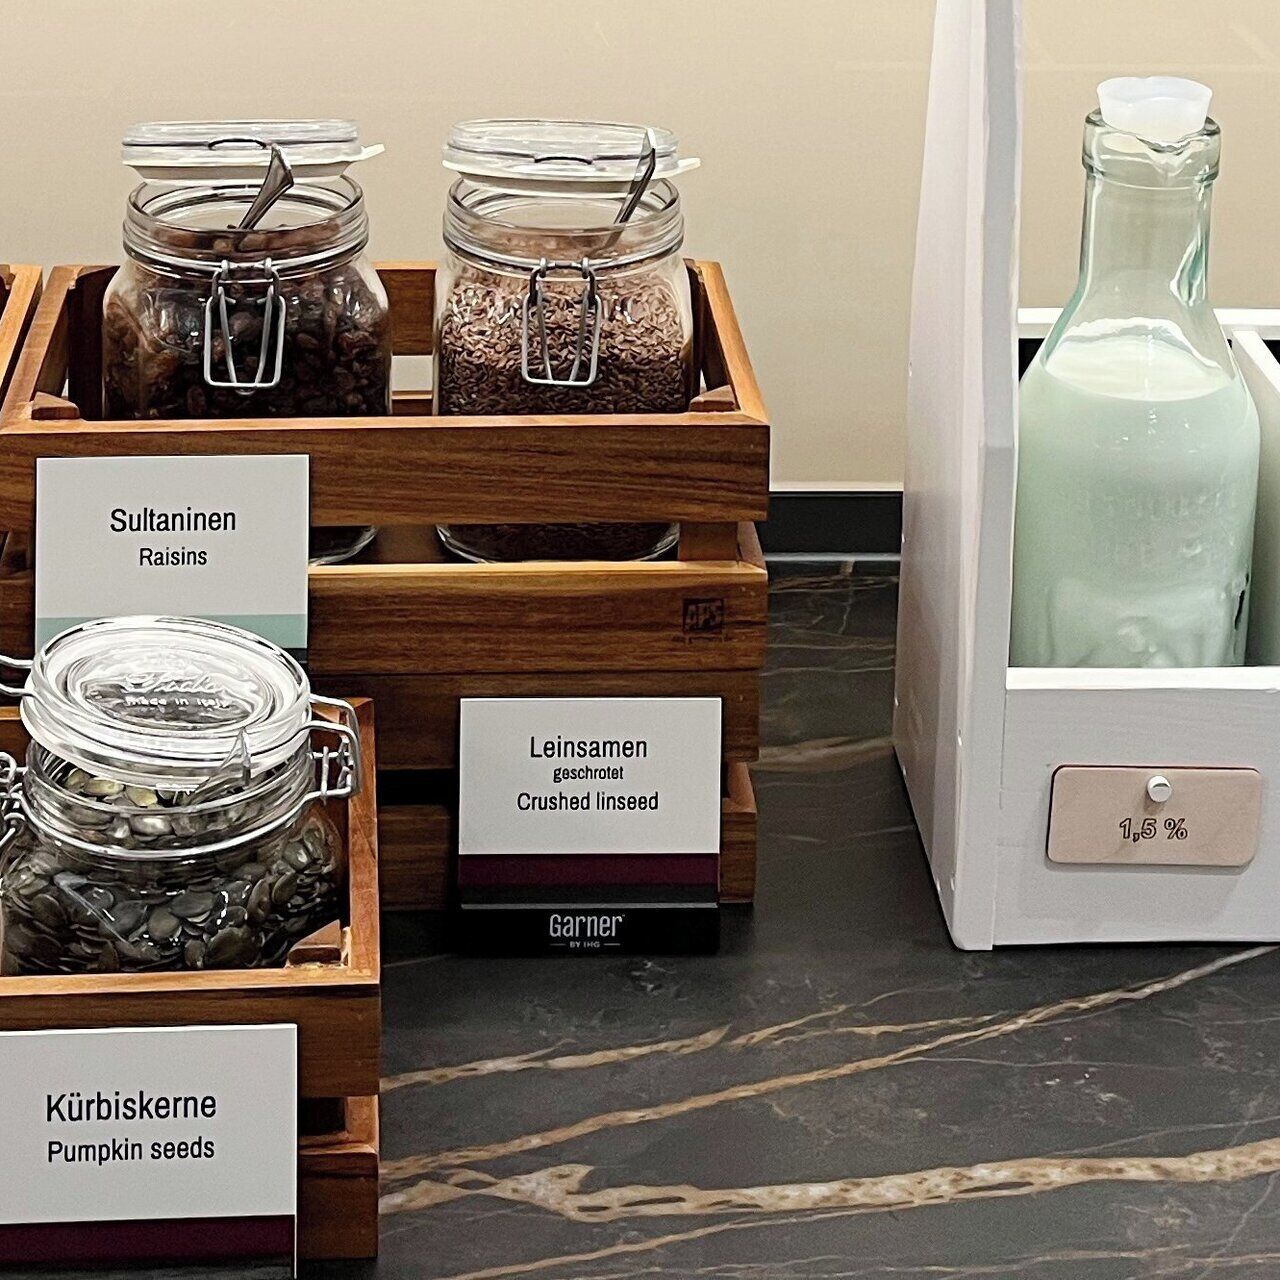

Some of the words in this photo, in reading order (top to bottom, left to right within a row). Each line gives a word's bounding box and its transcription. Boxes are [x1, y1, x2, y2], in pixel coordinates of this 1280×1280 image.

[109, 506, 236, 533] Sultaninen
[139, 546, 208, 567] Raisins
[530, 735, 647, 759] Leinsamen
[552, 764, 624, 784] geschrotet
[517, 791, 591, 811] Crushed
[596, 791, 659, 811] linseed
[1119, 817, 1158, 843] 1,5
[1163, 817, 1190, 841] %
[549, 913, 626, 938] Garner
[569, 940, 581, 948] BY
[583, 940, 601, 948] IHG
[46, 1089, 217, 1123] Kürbiskerne
[48, 1137, 143, 1167] Pumpkin
[150, 1135, 215, 1160] seeds
